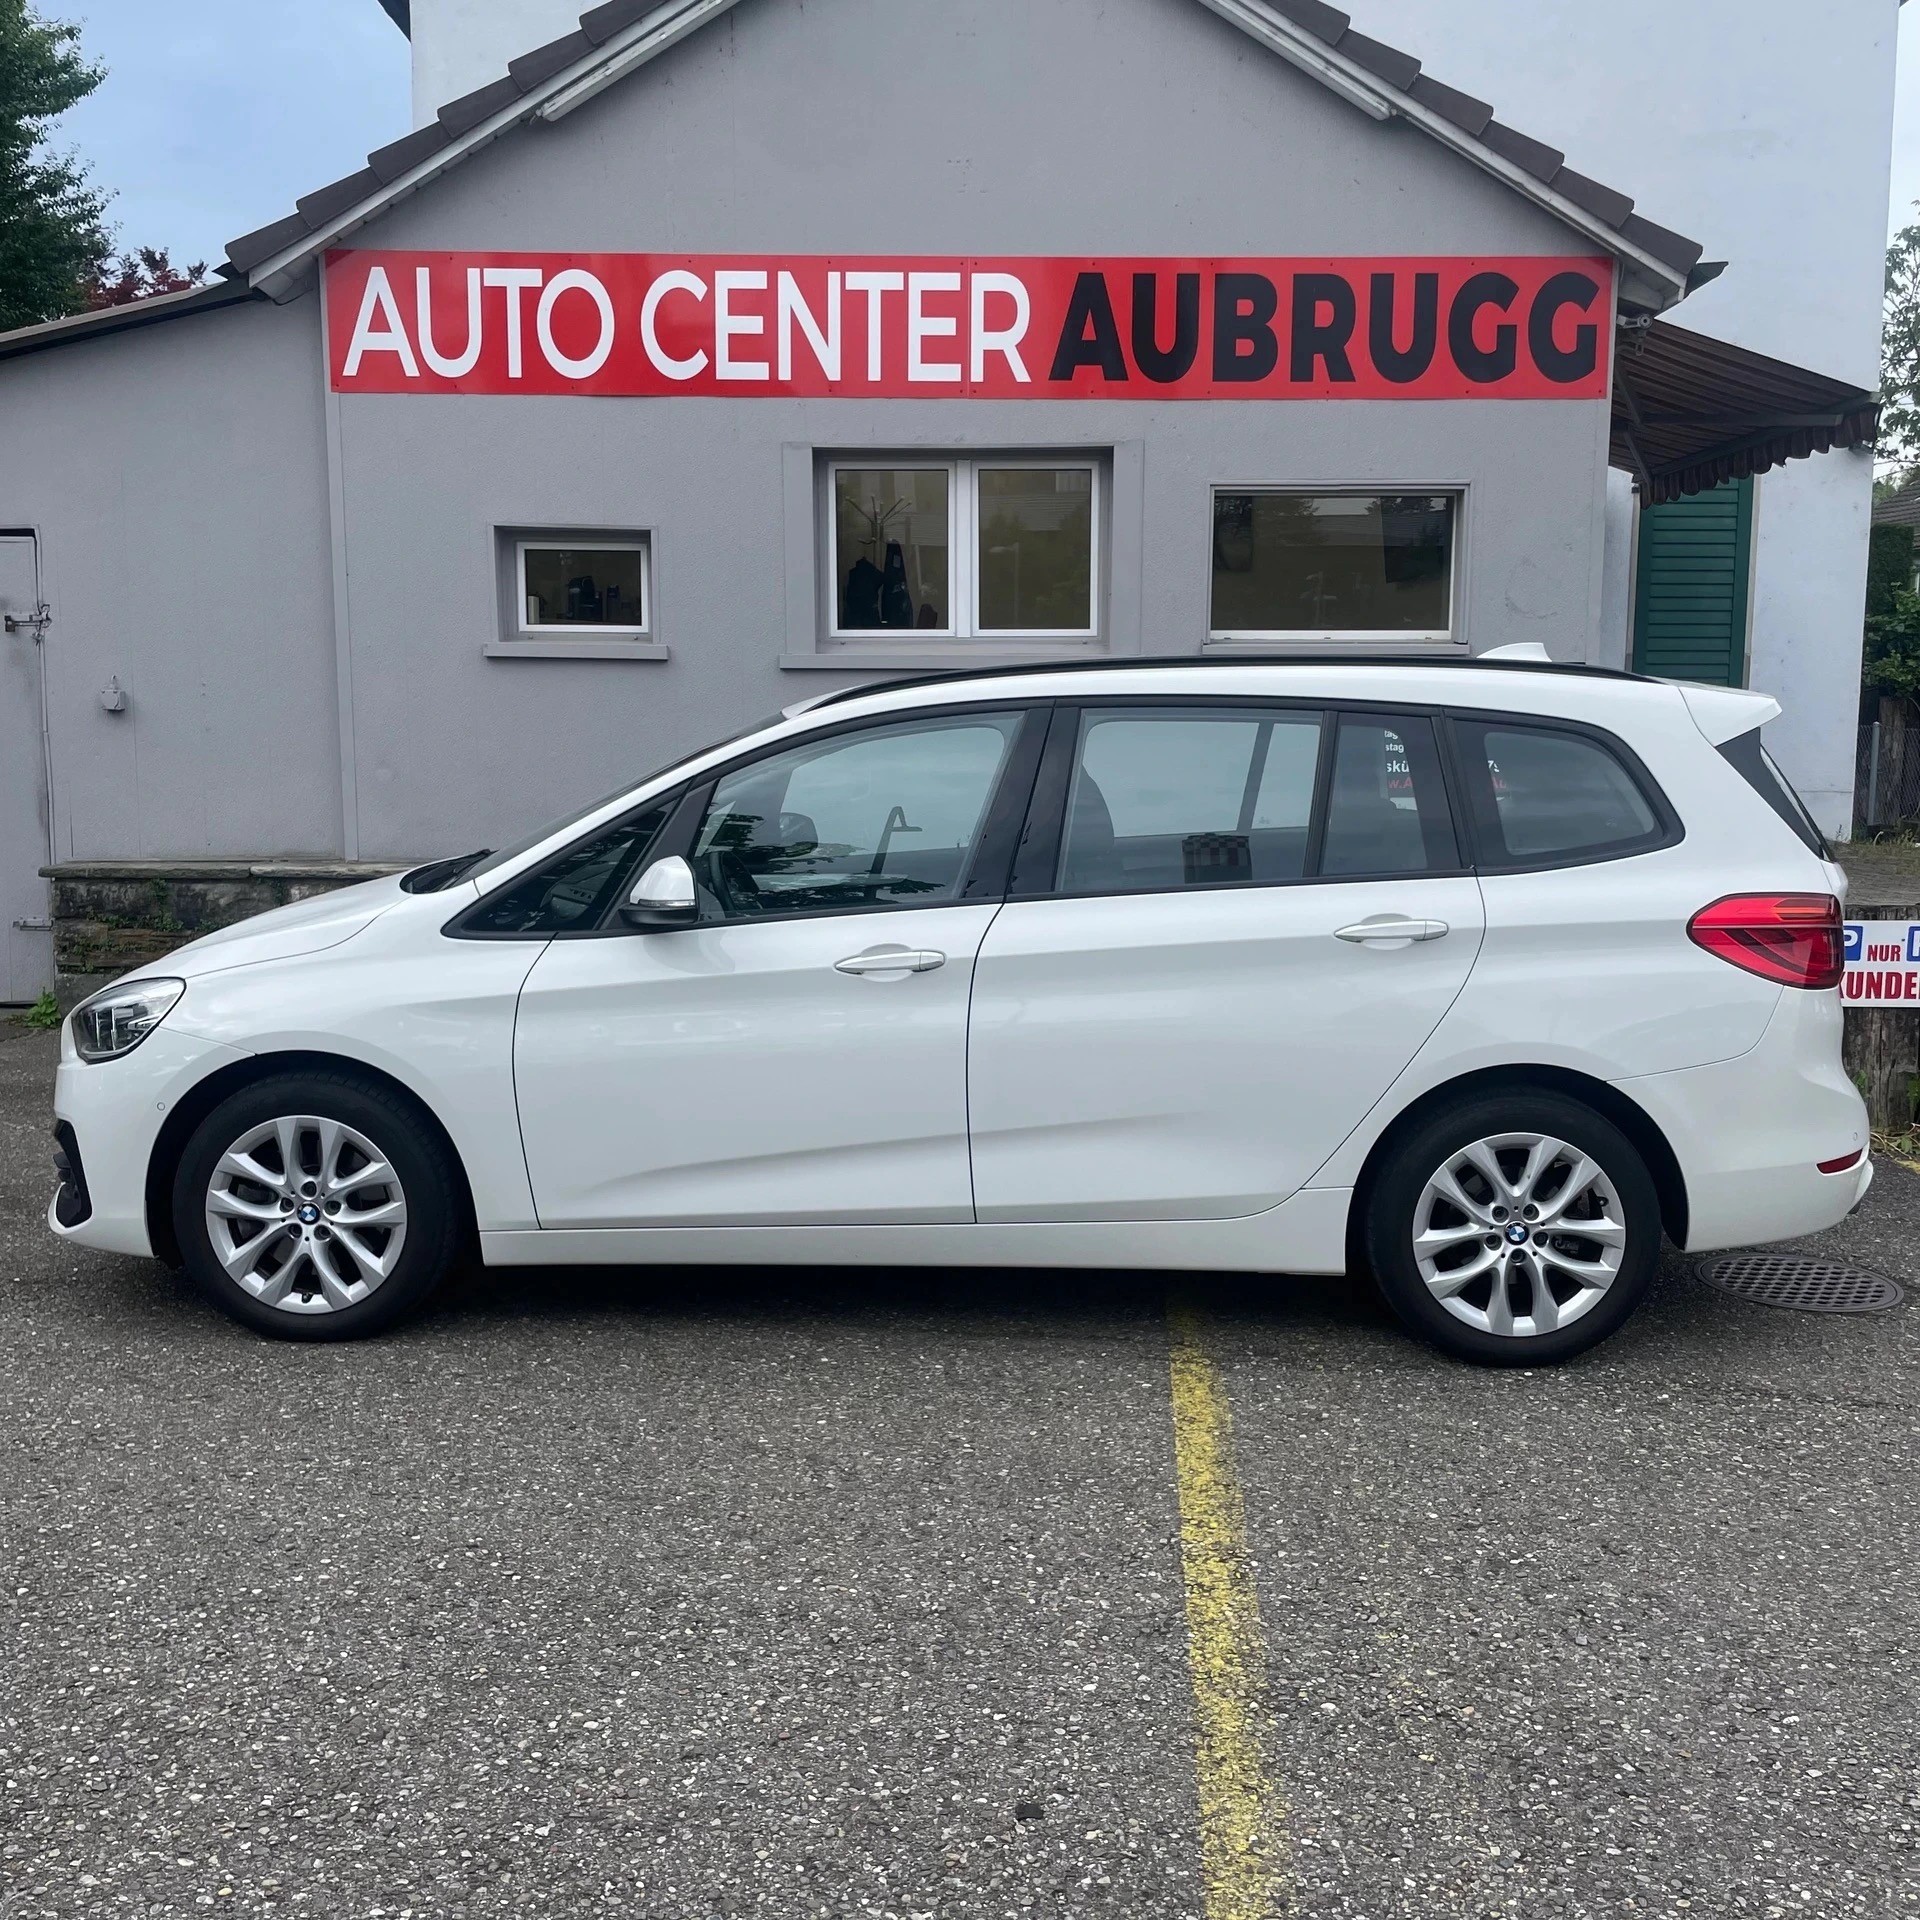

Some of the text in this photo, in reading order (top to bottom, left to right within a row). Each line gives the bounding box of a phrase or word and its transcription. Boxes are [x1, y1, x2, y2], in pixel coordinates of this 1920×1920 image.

[342, 266, 1600, 384] AUTO CENTER AUBRUGG
[1867, 944, 1901, 962] NUR
[1839, 971, 1920, 1000] UNDE
